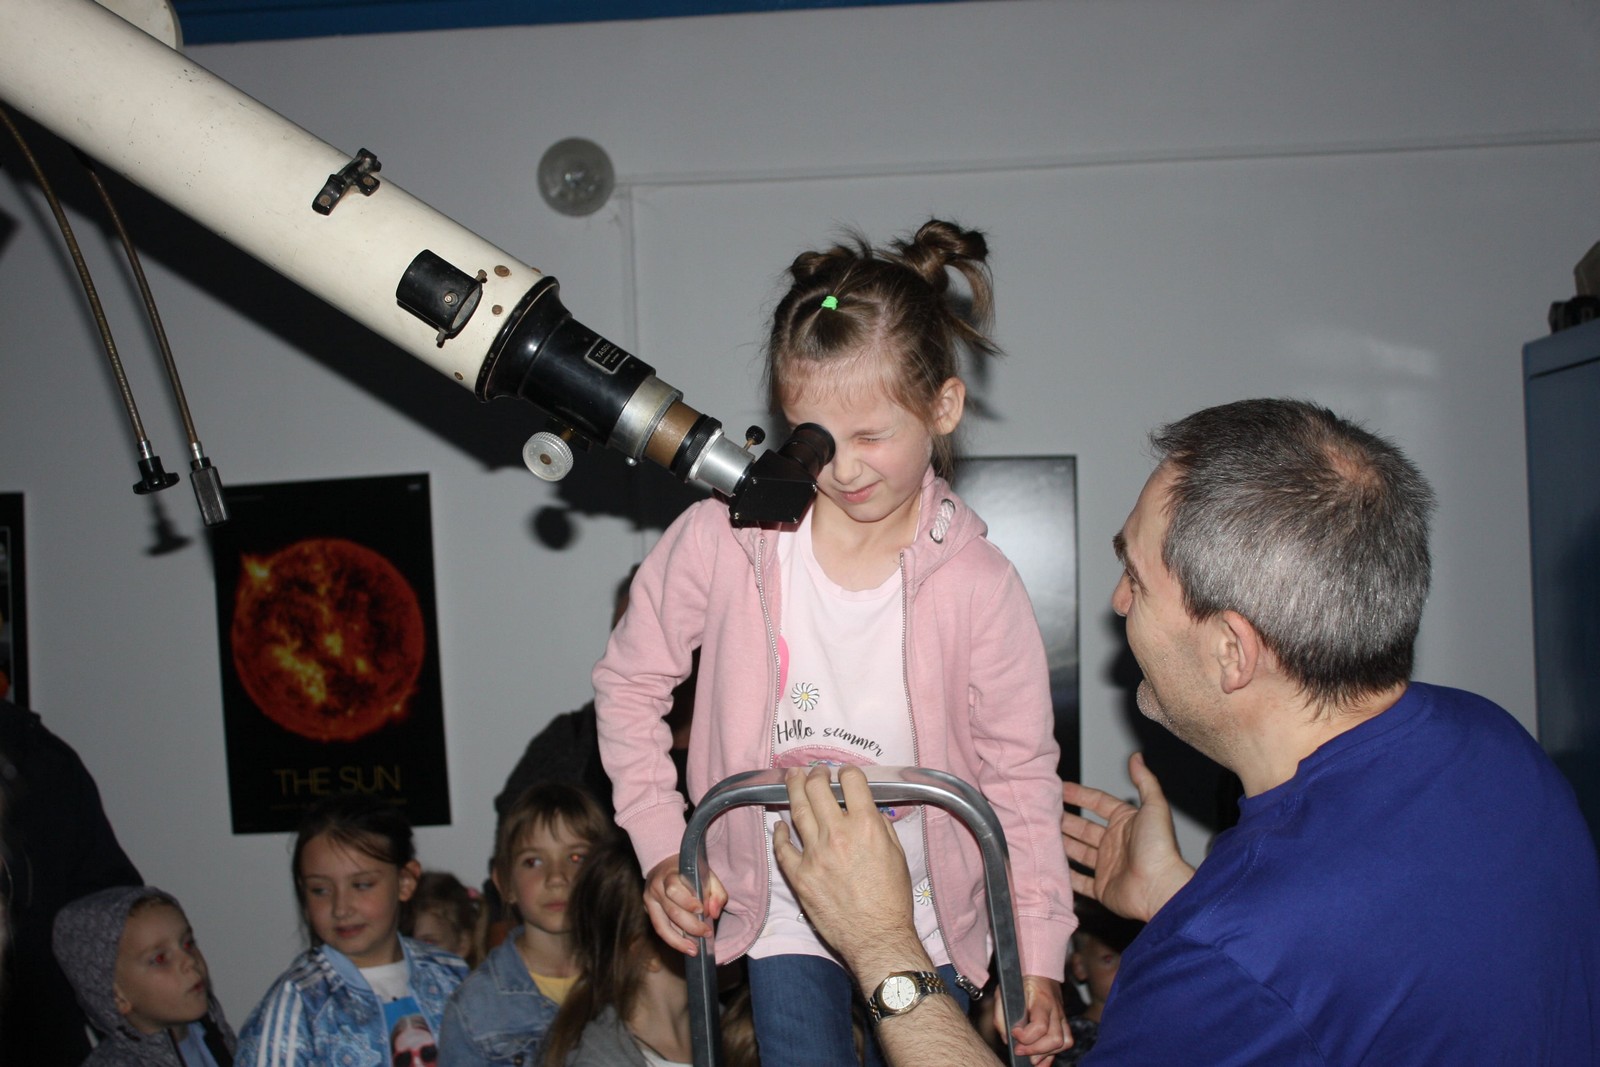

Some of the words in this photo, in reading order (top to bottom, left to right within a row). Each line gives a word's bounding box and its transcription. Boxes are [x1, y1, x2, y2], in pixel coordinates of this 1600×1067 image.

[777, 719, 815, 744] Hello
[823, 727, 884, 757] summer
[273, 766, 331, 796] THE
[339, 764, 402, 794] SUN
